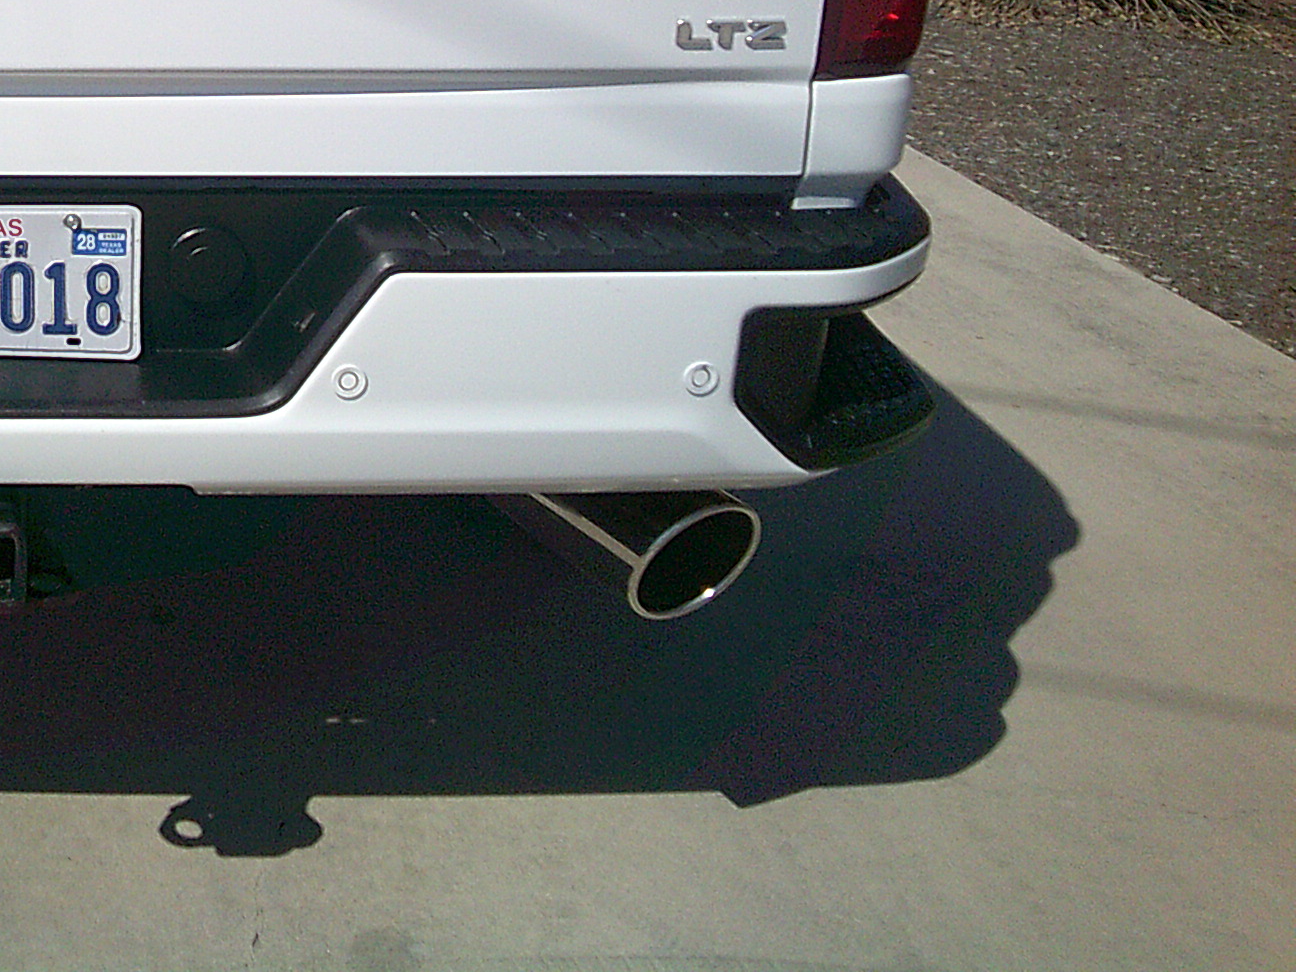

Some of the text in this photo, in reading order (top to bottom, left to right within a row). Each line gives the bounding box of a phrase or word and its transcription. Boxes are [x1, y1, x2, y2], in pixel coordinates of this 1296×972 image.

[676, 18, 788, 51] LTZ
[77, 233, 96, 250] 28
[0, 261, 121, 336] 018
